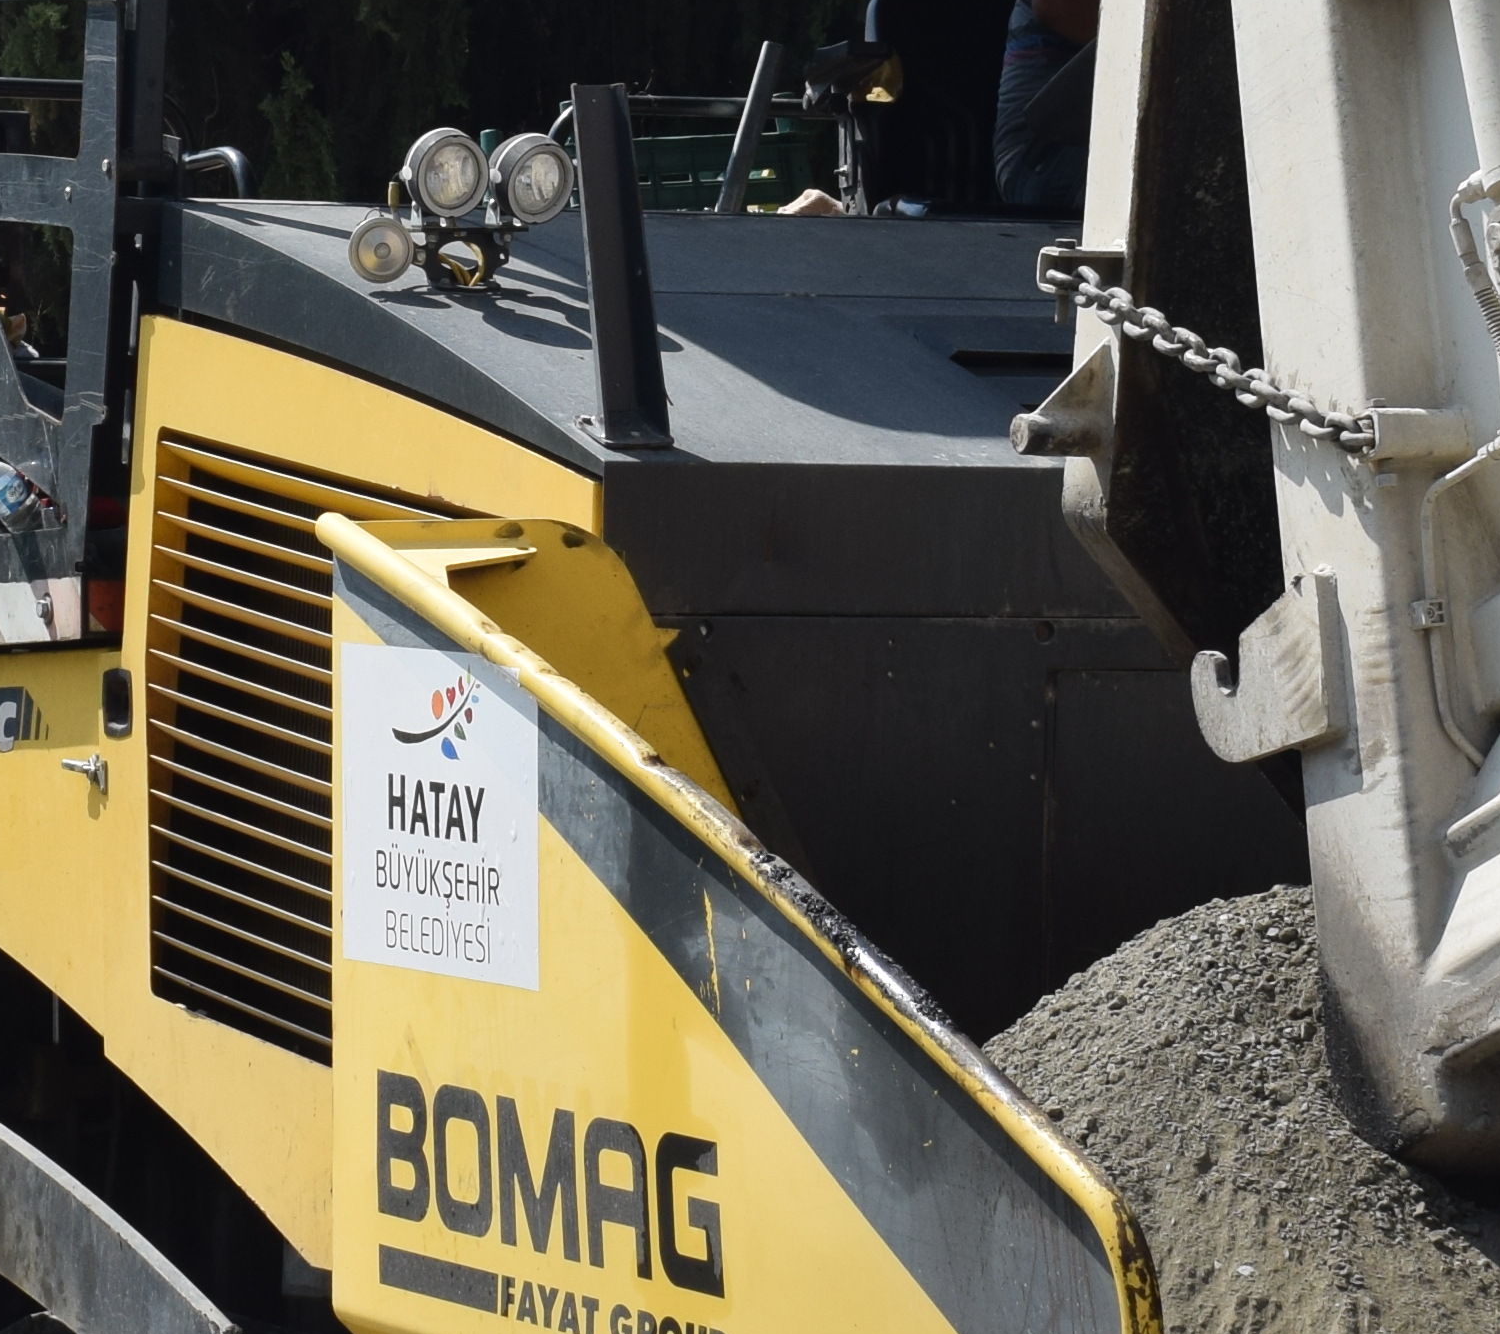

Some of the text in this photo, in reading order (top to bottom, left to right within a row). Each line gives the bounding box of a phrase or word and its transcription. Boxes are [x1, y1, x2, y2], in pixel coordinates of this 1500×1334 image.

[388, 773, 485, 843] HATAY
[376, 843, 500, 909] BÜYÜKŞEHİR
[386, 910, 490, 964] BELEDİYESİ
[377, 1069, 725, 1299] BOMAG
